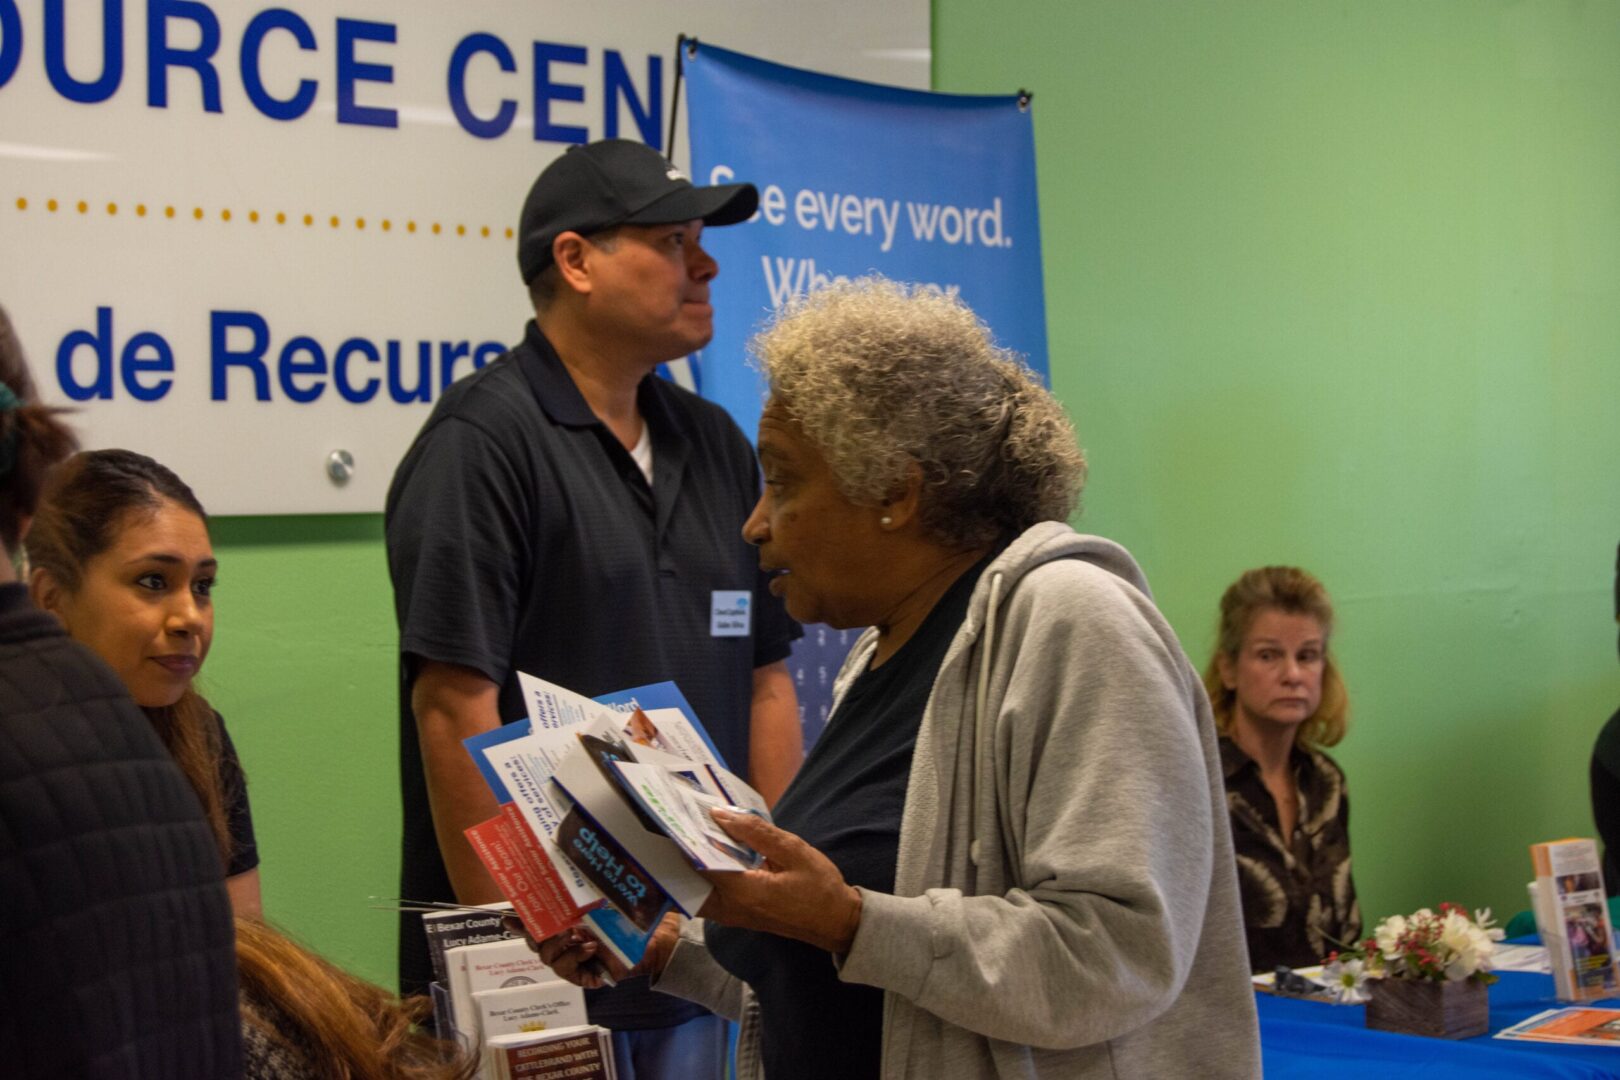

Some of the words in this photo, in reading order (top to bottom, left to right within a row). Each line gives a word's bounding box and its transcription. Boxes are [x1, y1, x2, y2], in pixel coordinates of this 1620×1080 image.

[0, 0, 399, 129] URCE
[447, 32, 663, 152] CEN
[795, 187, 899, 251] every
[907, 198, 1012, 248] word.
[56, 306, 175, 402] de
[510, 771, 533, 803] offers
[504, 804, 533, 849] Assistance
[469, 828, 500, 872] Assistance
[572, 837, 602, 871] Here
[579, 826, 624, 876] Help
[496, 871, 518, 898] Senior
[512, 871, 527, 891] Our
[624, 873, 645, 898] to
[514, 897, 544, 937] Northeast
[525, 892, 543, 911] Join
[437, 922, 465, 933] Bexar
[466, 917, 500, 929] County
[443, 938, 466, 948] Lucy
